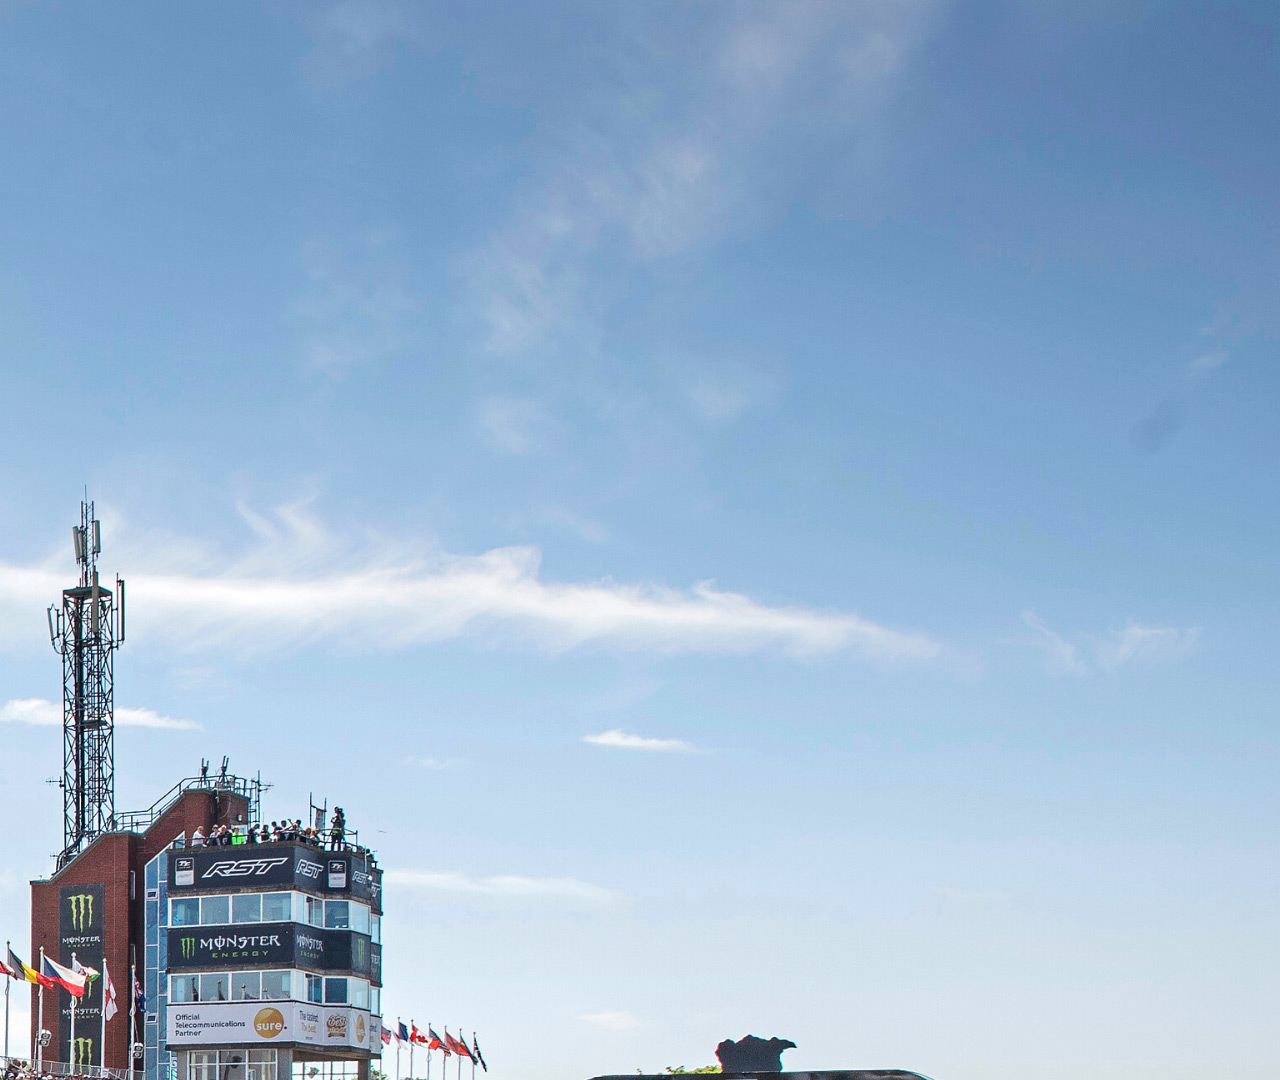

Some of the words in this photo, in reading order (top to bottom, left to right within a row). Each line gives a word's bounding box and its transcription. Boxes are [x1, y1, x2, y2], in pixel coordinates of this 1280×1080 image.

[201, 857, 289, 879] RST
[296, 858, 325, 879] RST
[200, 935, 281, 951] MONSTER
[212, 950, 270, 959] ENERGY
[175, 1013, 200, 1021] Official
[175, 1020, 246, 1029] Telecommunications
[175, 1029, 202, 1037] Partner
